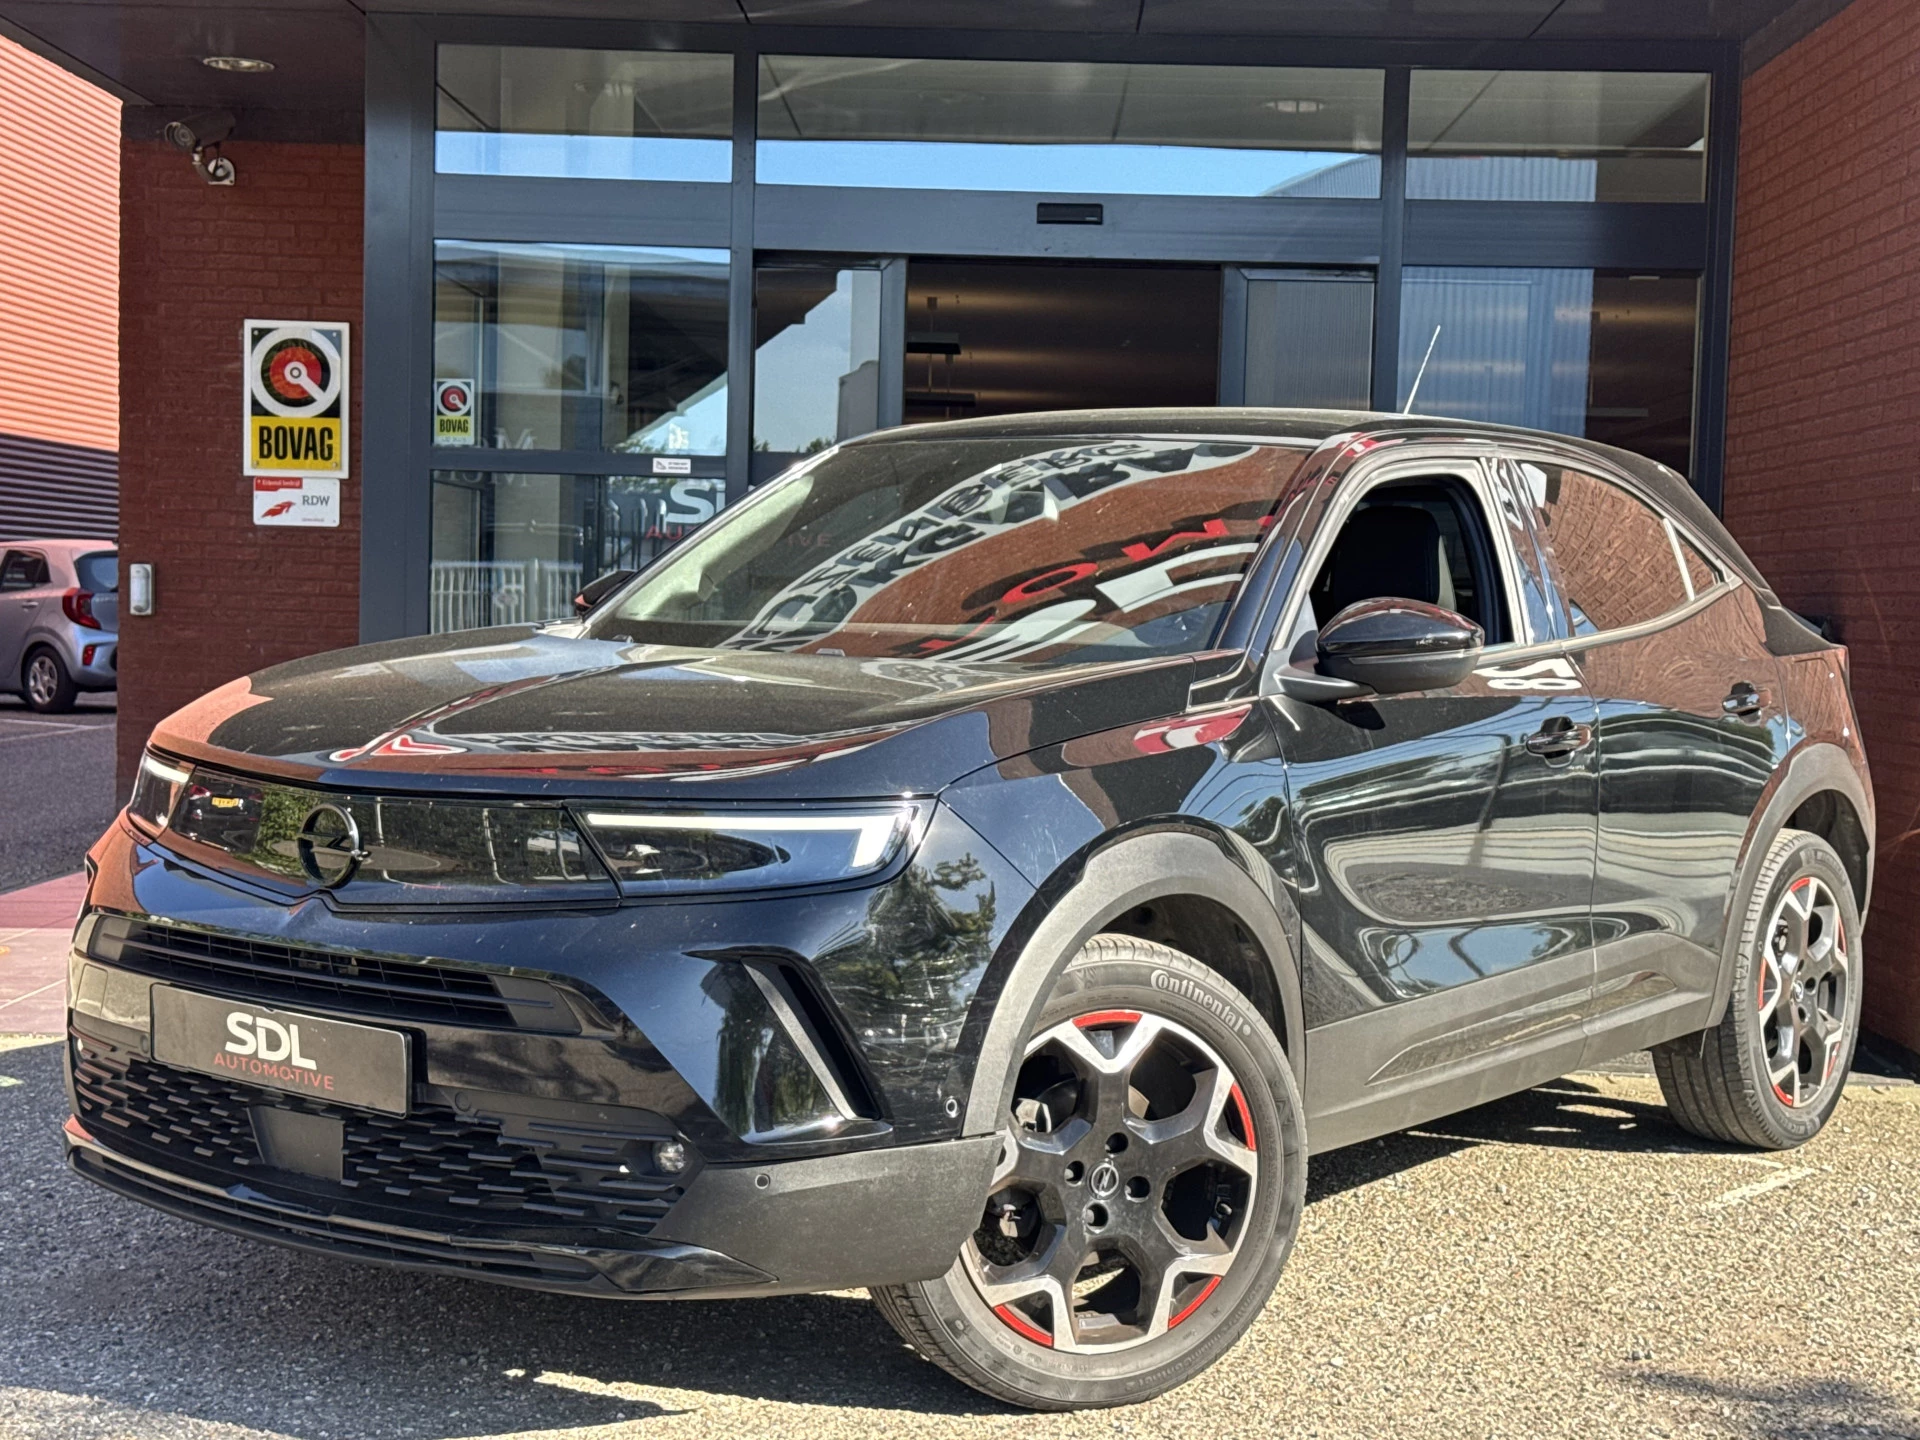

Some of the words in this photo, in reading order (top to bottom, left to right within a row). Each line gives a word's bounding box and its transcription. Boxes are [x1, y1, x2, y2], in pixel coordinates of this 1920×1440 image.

[259, 426, 333, 461] BOVAG
[440, 419, 469, 433] BOVAG
[302, 495, 331, 507] RDW
[1150, 969, 1244, 1033] Continental
[225, 1011, 317, 1071] SDL
[213, 1052, 334, 1091] AUTOMOTIVE
